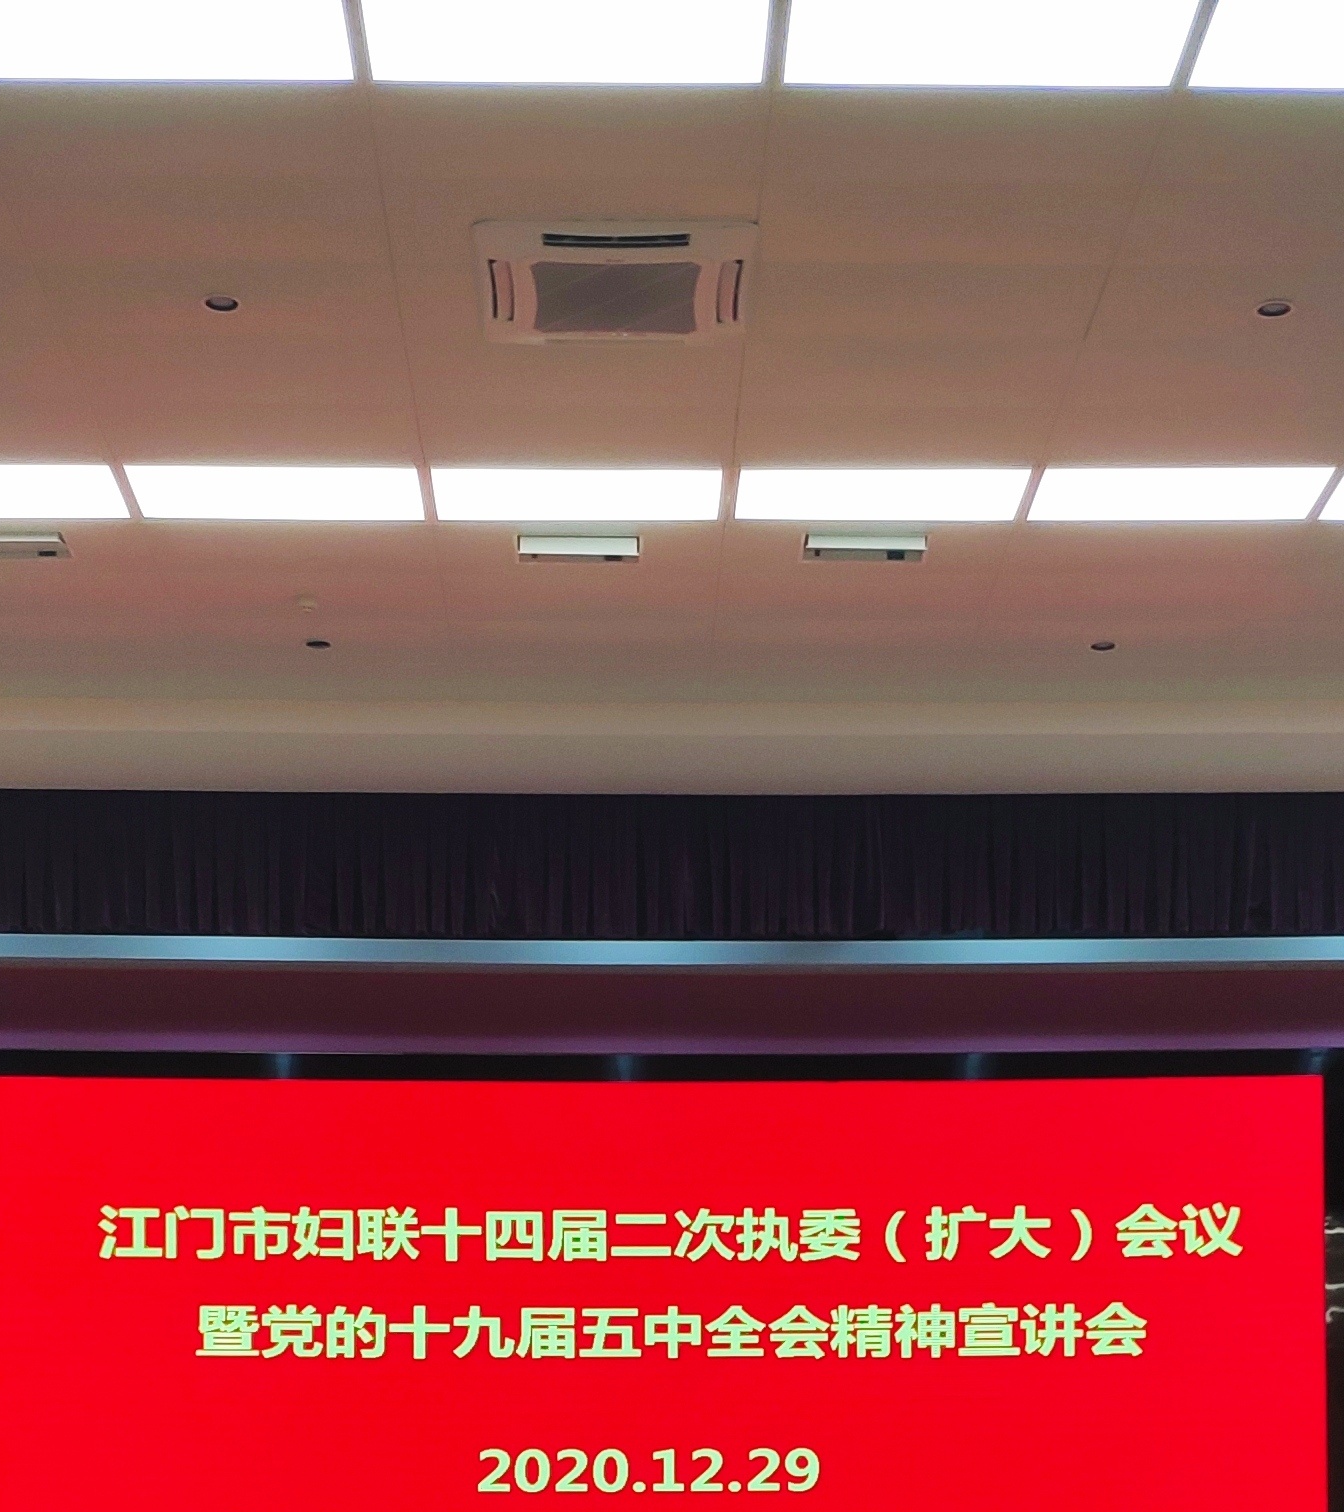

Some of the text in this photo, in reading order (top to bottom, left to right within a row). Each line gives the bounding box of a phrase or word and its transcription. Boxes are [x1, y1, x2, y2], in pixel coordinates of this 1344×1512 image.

[97, 1202, 1243, 1263] 江门市妇联十四届二次执委（扩大）会议
[195, 1301, 1148, 1360] 暨党的十九届五中全会精神宣讲会
[477, 1447, 820, 1493] 2020.12.29
